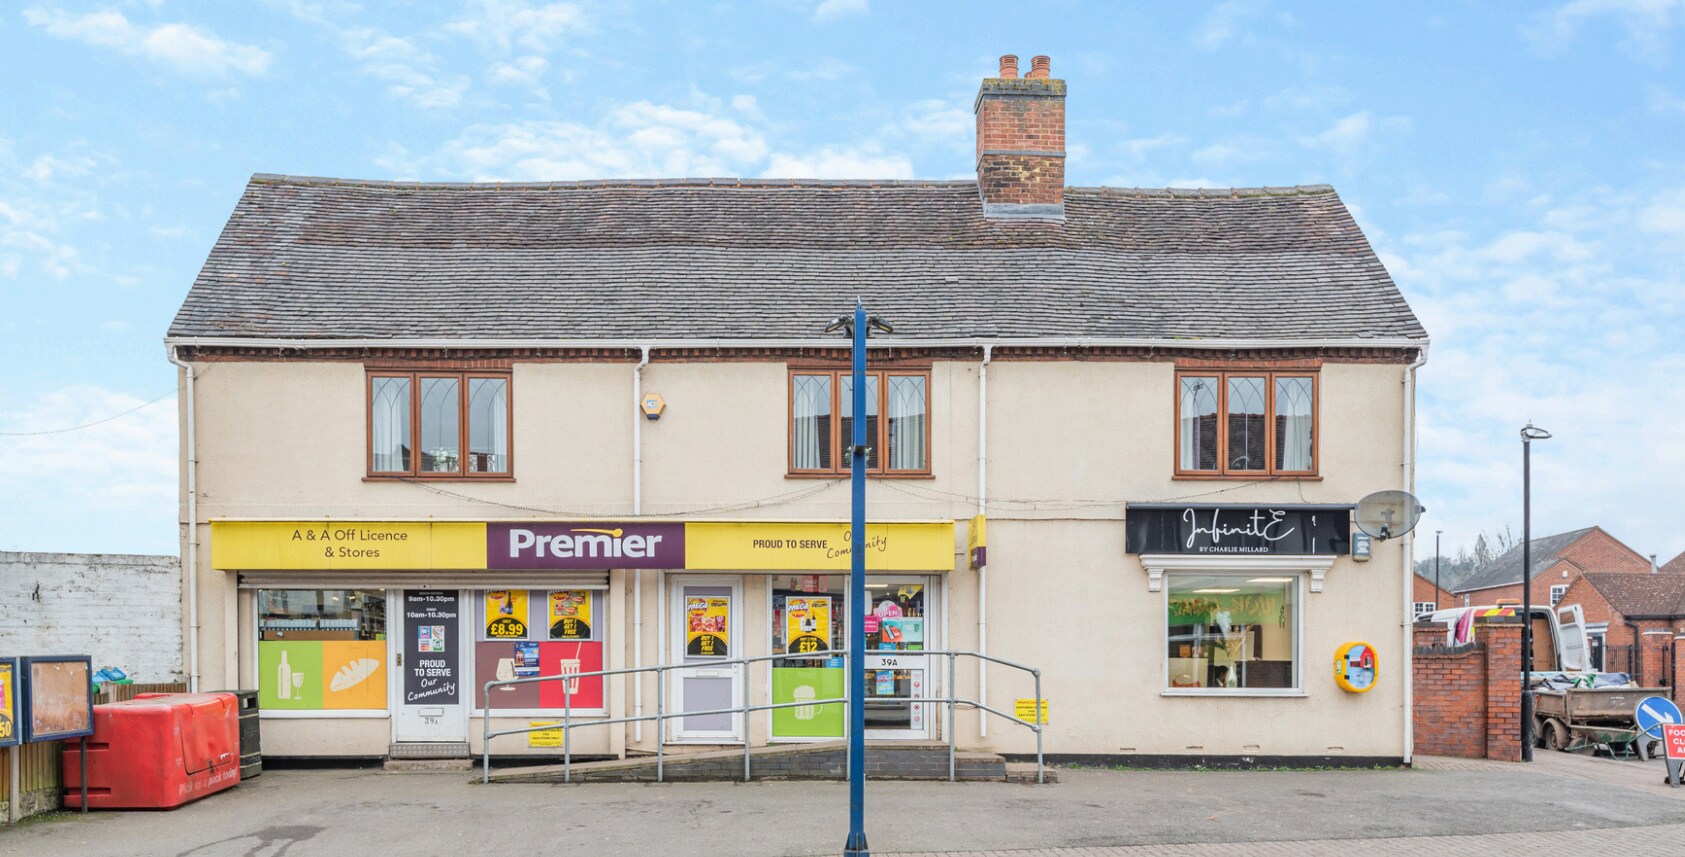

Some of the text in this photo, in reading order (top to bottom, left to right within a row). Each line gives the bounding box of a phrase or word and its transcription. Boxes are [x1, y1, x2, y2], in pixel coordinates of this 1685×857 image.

[292, 529, 408, 540] A & A Off Licence
[509, 528, 662, 558] Premier
[753, 539, 827, 549] PROUD TO SERVE
[827, 535, 887, 558] Comnity
[324, 546, 380, 557] & Stores
[491, 623, 524, 635] £8.99
[799, 641, 818, 653] £12
[419, 659, 446, 667] PROUD
[881, 658, 898, 666] 39A
[414, 668, 451, 676] TO SERVE
[420, 678, 438, 688] Our
[407, 682, 456, 701] Community
